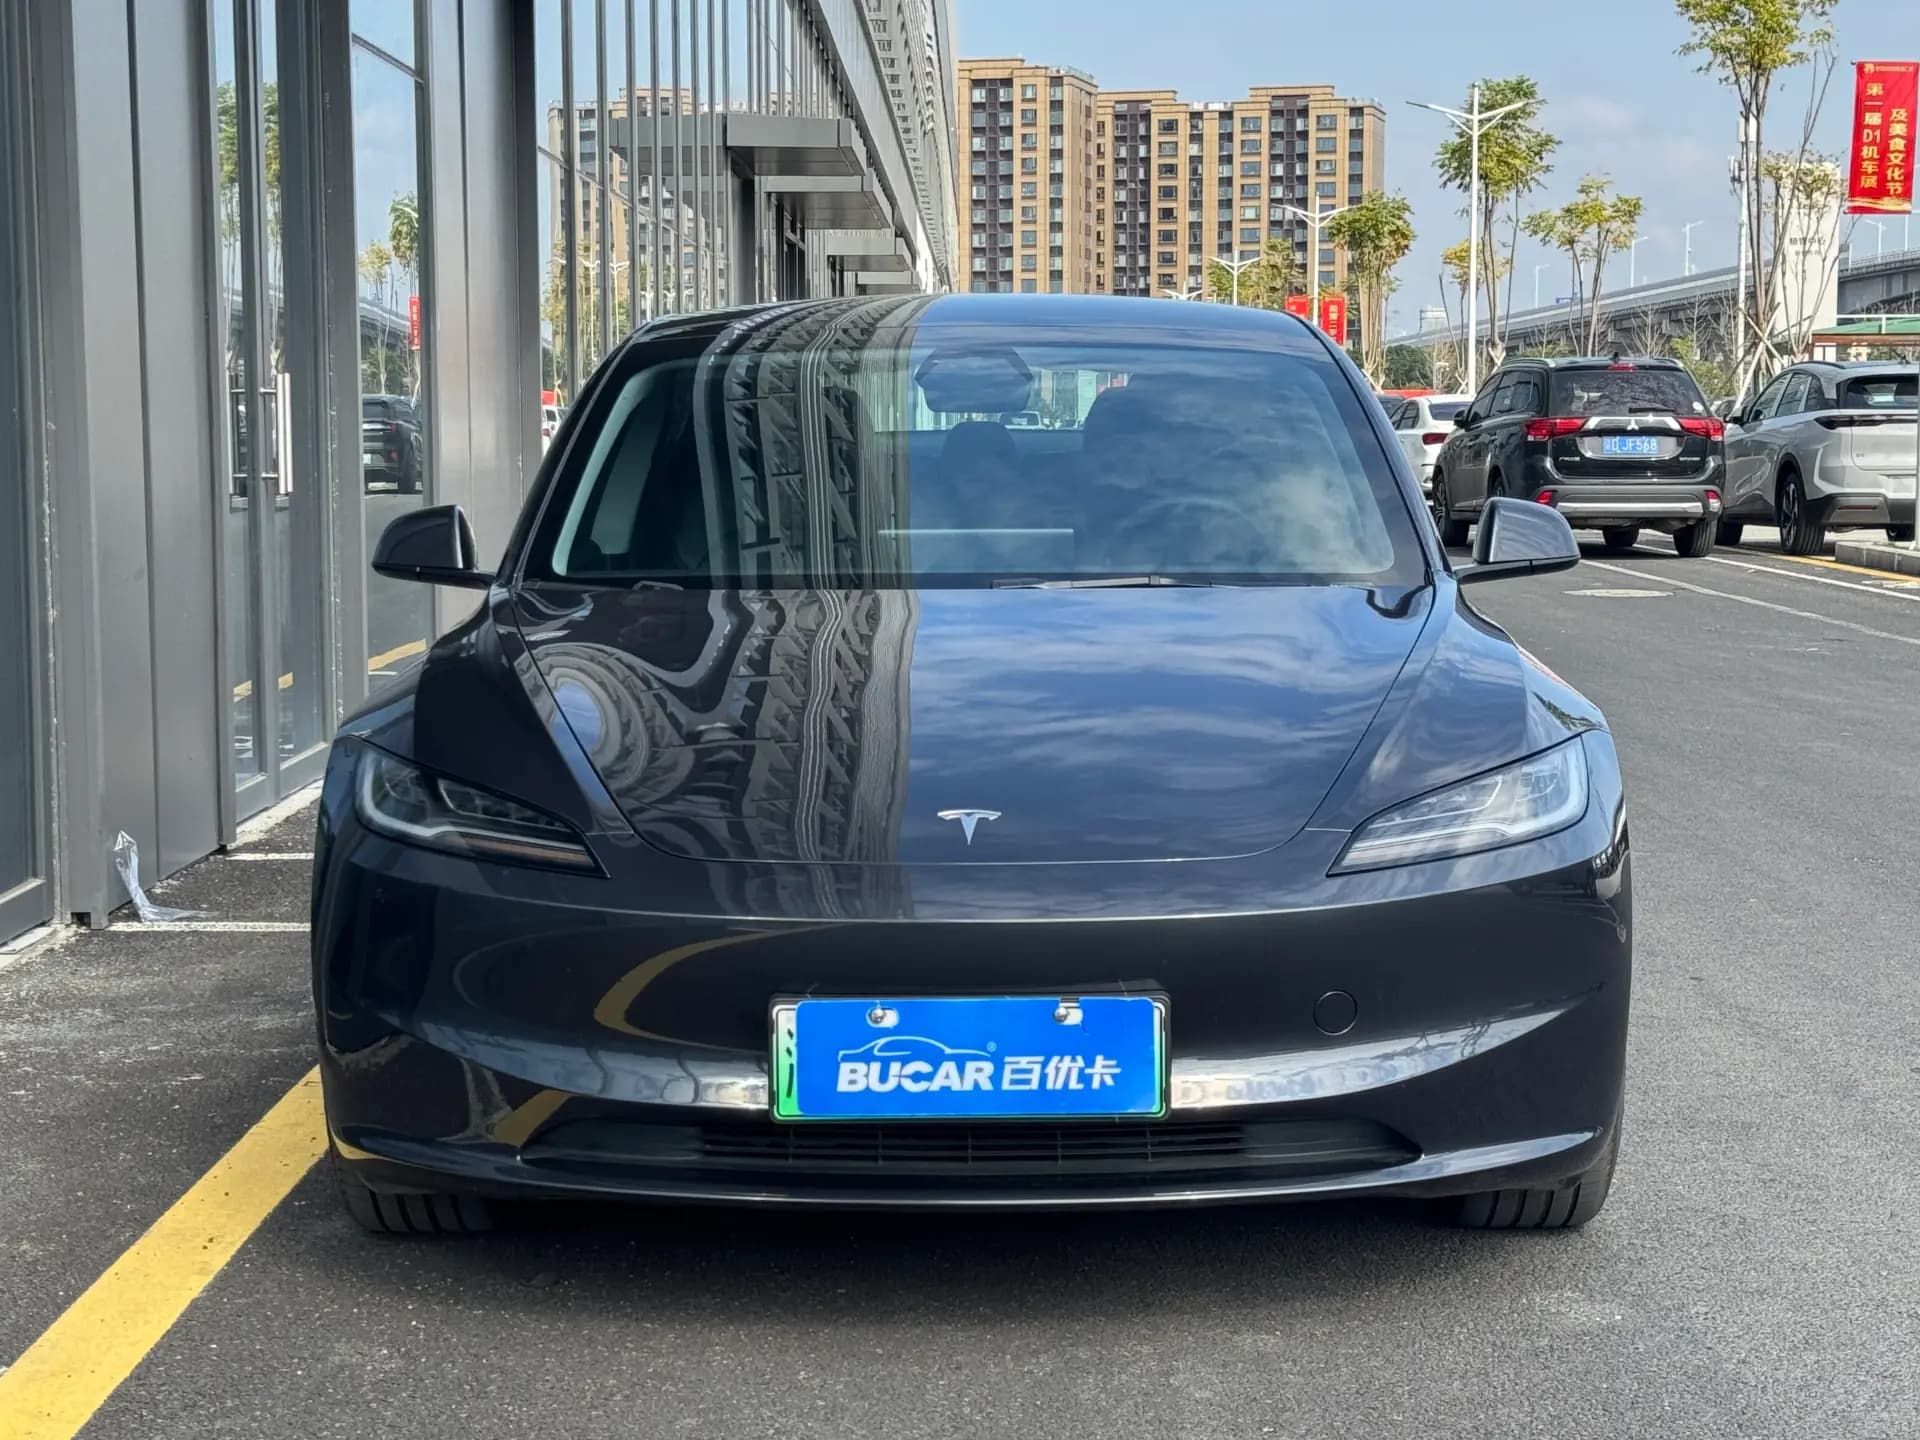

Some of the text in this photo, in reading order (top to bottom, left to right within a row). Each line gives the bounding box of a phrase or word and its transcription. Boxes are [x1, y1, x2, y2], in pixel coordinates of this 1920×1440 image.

[1860, 82, 1884, 189] 第一届D1机车展
[1885, 108, 1908, 196] 及美食文化节
[836, 1060, 994, 1093] BUCAR
[1001, 1055, 1122, 1091] 百优卡
